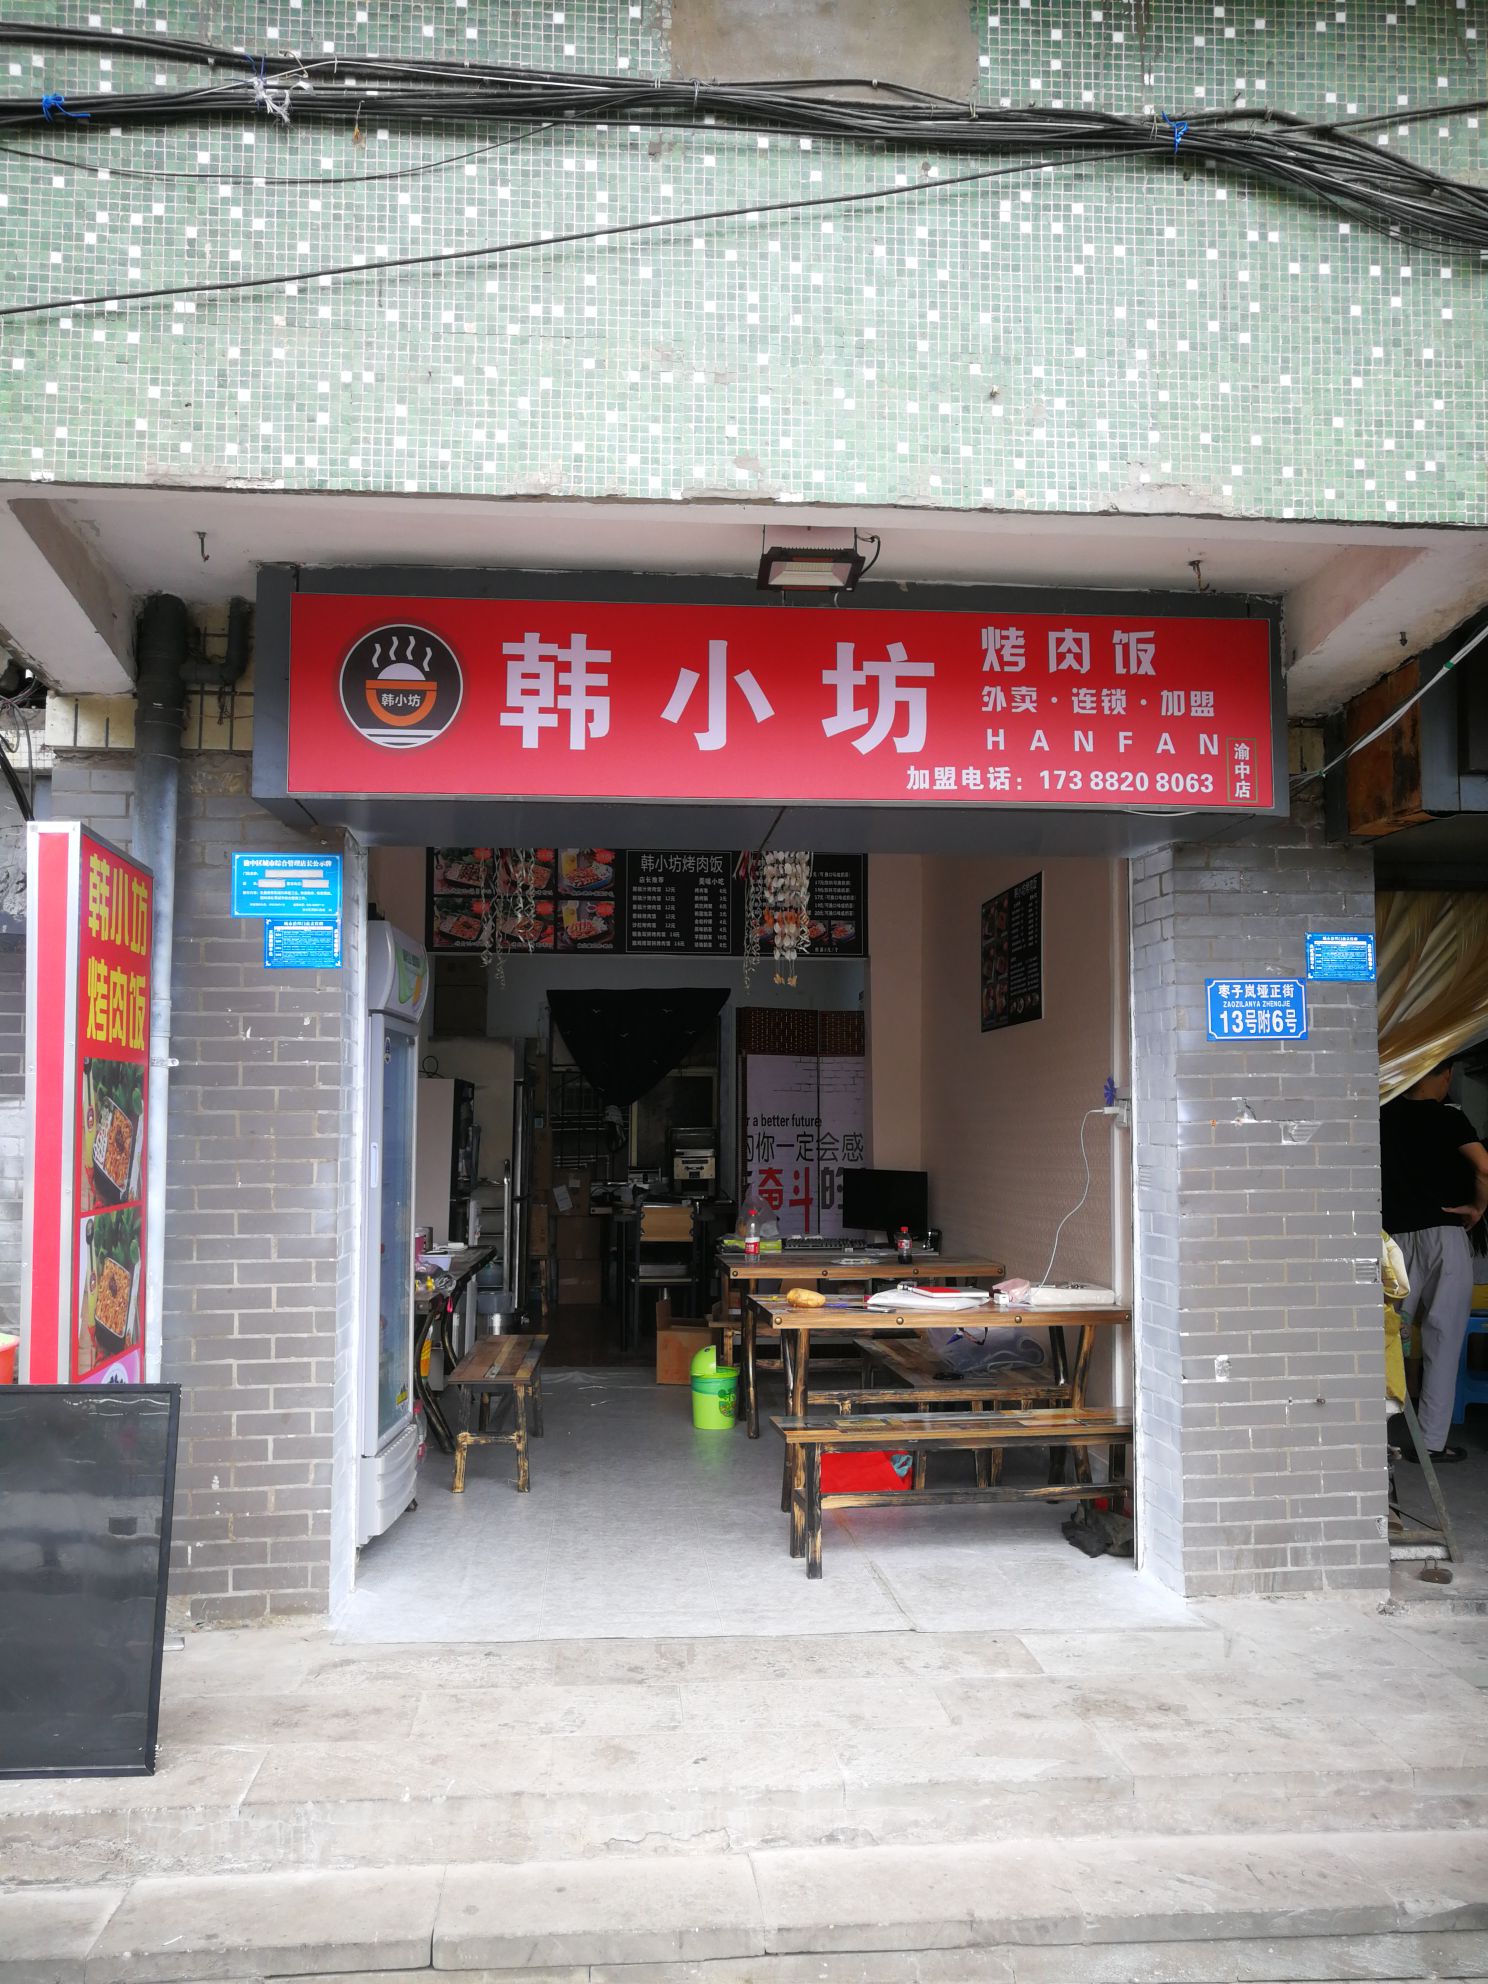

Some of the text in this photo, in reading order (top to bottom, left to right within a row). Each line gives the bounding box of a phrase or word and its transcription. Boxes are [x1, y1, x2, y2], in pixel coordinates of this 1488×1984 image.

[981, 626, 1157, 676] 烤肉饭
[381, 693, 421, 707] 韩小坊
[500, 632, 935, 755] 韩小坊
[1039, 770, 1083, 790] 173
[1089, 772, 1150, 792] 8820
[1155, 773, 1215, 793] 8063
[1233, 743, 1251, 798] 渝中店
[641, 854, 723, 873] 韩小坊烤肉饭
[88, 853, 149, 956] 韩小坊
[1218, 983, 1295, 999] 枣子岚垭正街
[86, 956, 146, 1051] 烤肉饭
[1223, 1000, 1291, 1008] ZAOZILANYA ZHENGJIE
[1219, 1009, 1298, 1034] 13号附6号
[753, 1117, 759, 1127] a
[761, 1113, 790, 1127] better
[791, 1113, 823, 1127] future
